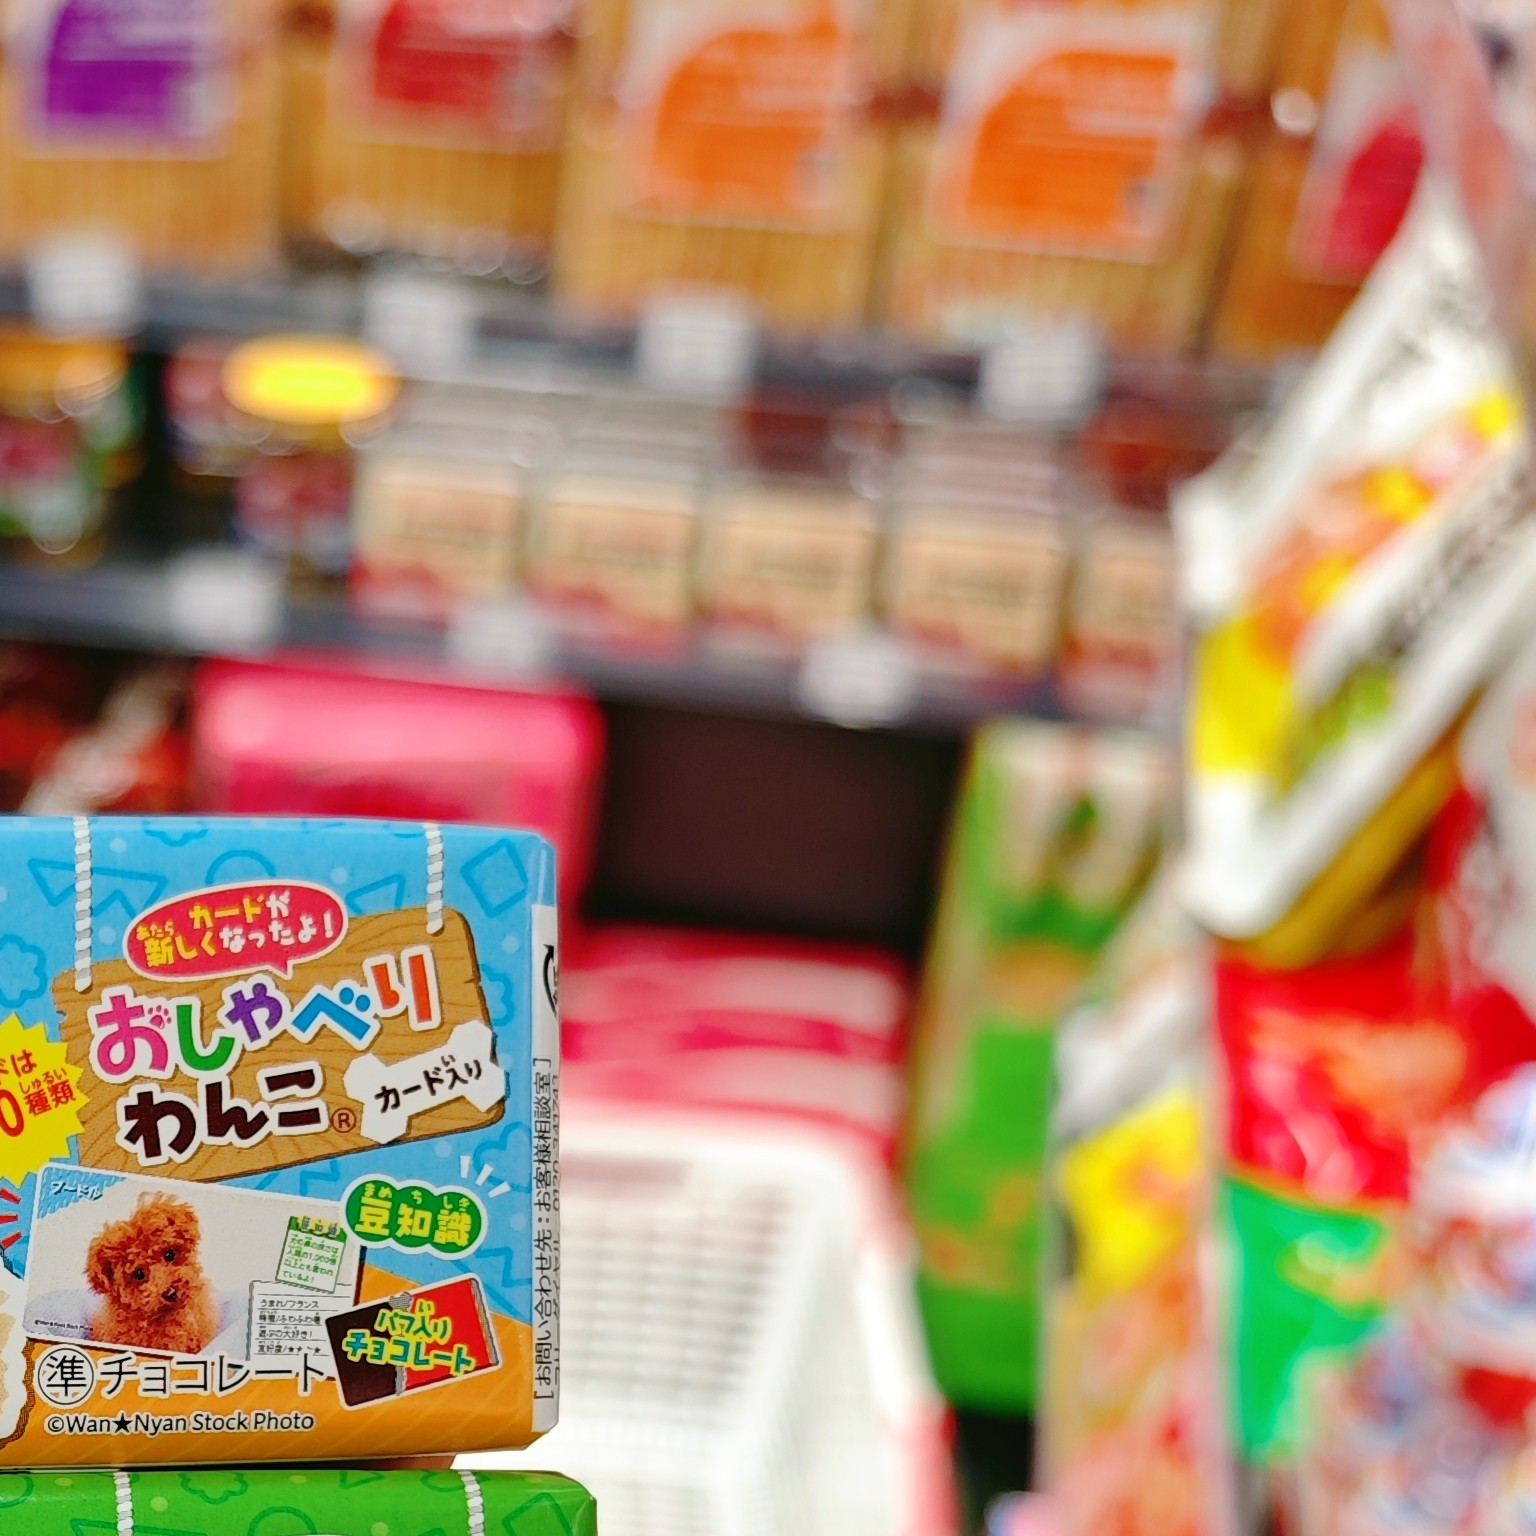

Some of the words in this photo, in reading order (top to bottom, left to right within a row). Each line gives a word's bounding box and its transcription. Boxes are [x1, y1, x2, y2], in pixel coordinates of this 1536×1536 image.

[189, 889, 291, 929] カードが
[95, 953, 432, 1076] おしゃべり
[374, 1059, 482, 1113] カード入り
[354, 1196, 472, 1246] 豆知識
[345, 1332, 472, 1373] チョコレート
[193, 1412, 248, 1431] Stock
[253, 1412, 314, 1431] Photo
